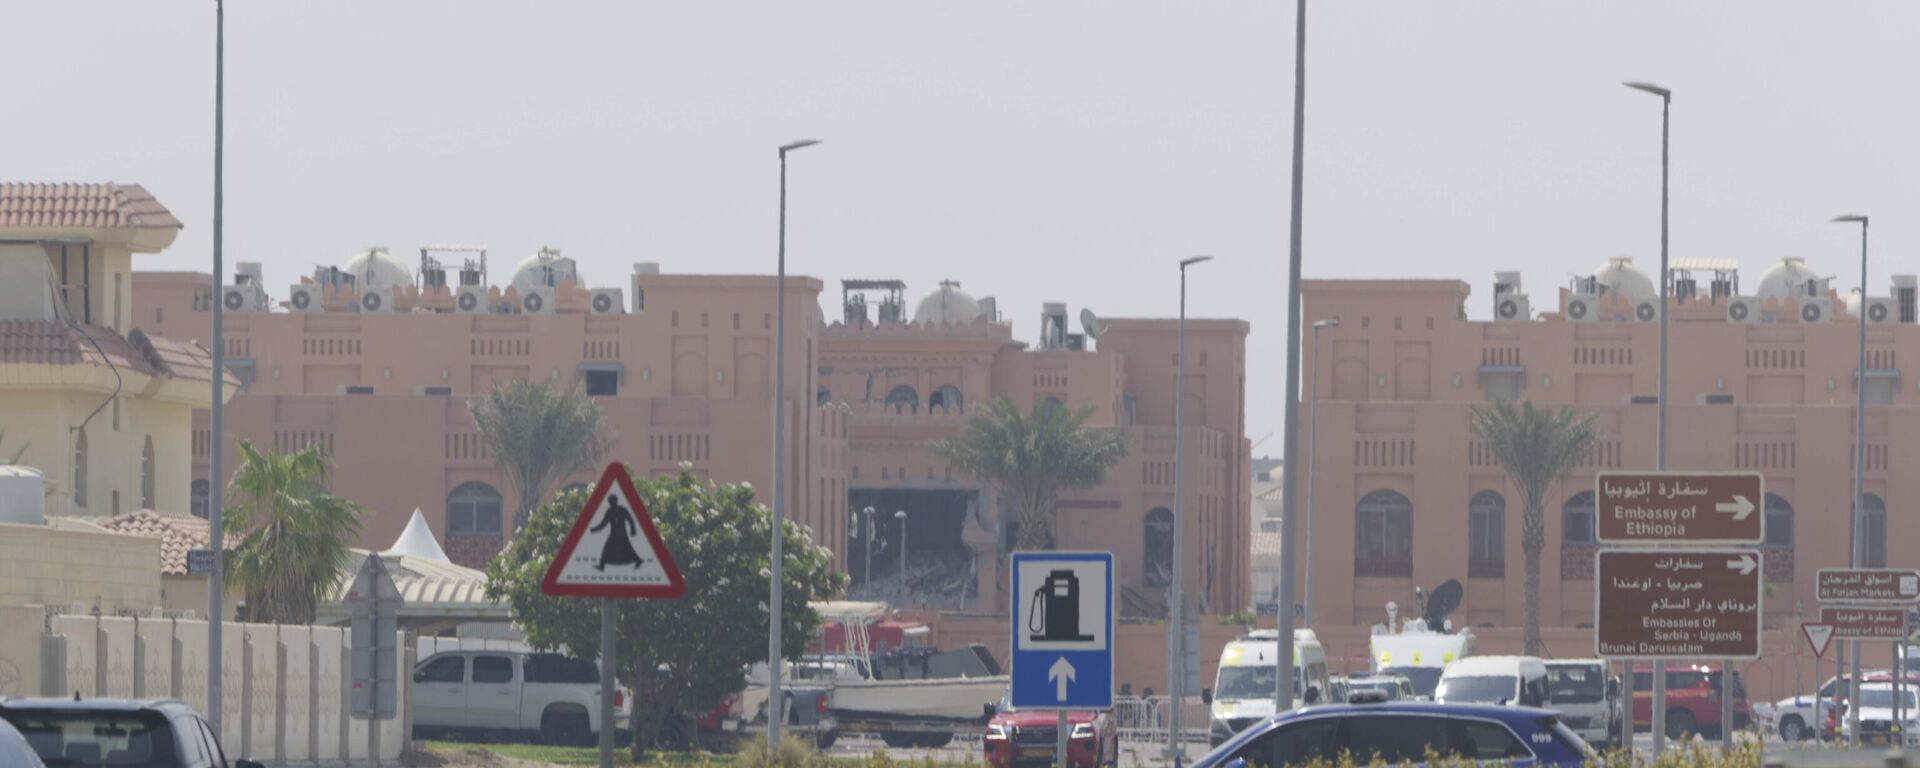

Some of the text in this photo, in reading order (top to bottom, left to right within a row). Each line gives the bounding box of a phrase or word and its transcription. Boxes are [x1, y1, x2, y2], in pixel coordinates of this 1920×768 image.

[1658, 481, 1708, 500] سفارة
[1614, 505, 1697, 523] Embassy of
[1626, 520, 1686, 537] Ethiopia
[1655, 556, 1704, 572] سفارات
[1666, 577, 1703, 593] صربيا
[1651, 597, 1757, 614] بروناي دار السلام
[1642, 616, 1717, 629] Embassies Of
[1654, 629, 1690, 641] Serbia
[1699, 629, 1742, 643] Uganda
[1874, 625, 1904, 637] Ethiopi
[1601, 642, 1704, 654] Brunei Darussalam
